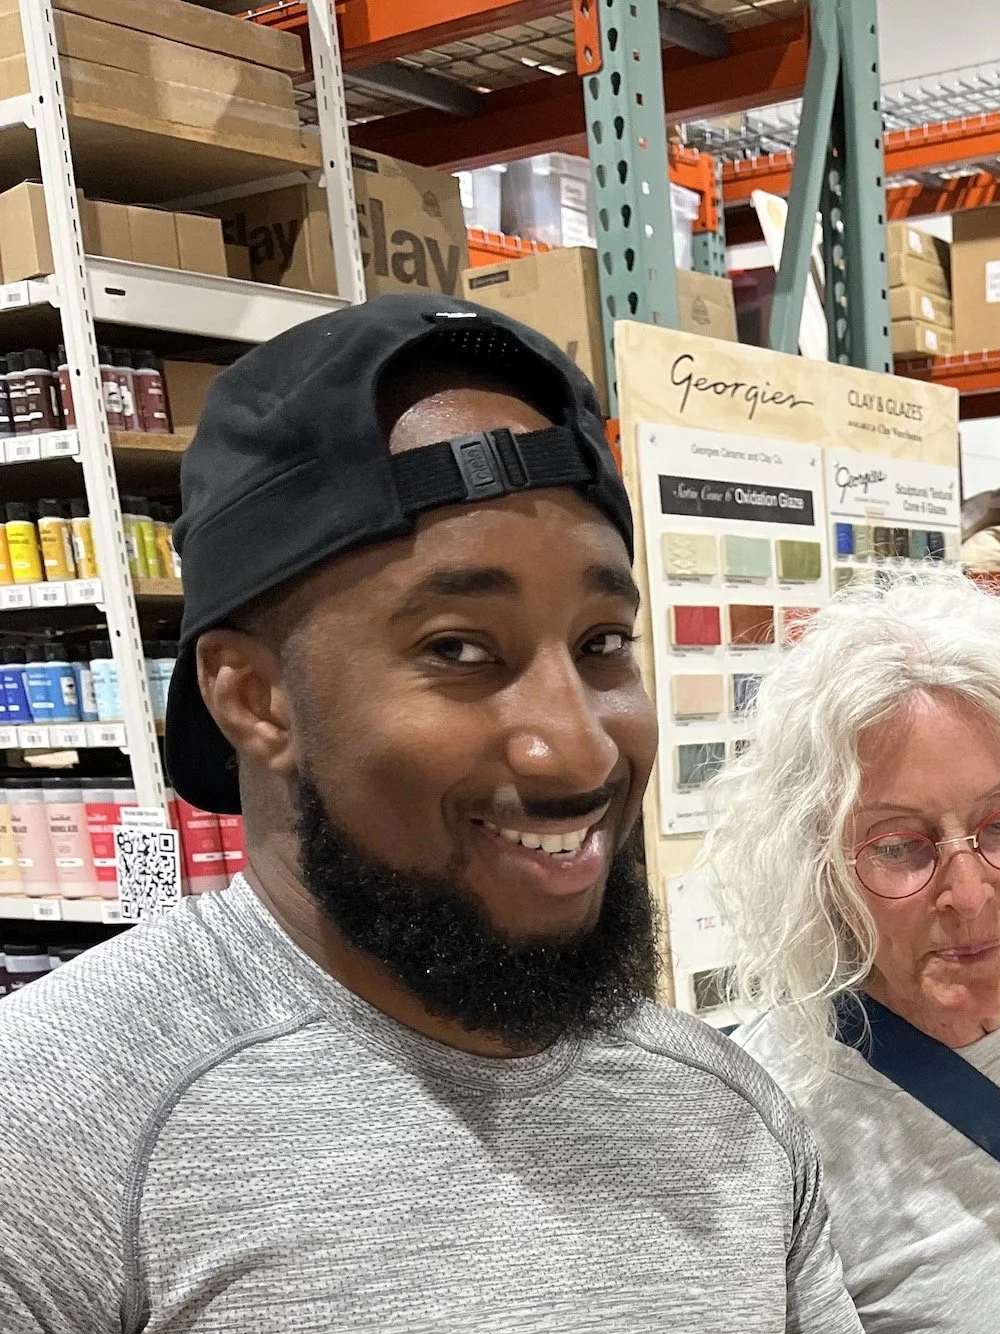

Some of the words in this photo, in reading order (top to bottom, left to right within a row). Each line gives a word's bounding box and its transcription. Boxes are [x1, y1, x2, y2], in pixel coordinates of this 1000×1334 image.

[358, 197, 461, 296] lay
[671, 354, 814, 420] Georgies
[847, 389, 876, 410] CLAY
[885, 399, 923, 421] GLAZES
[734, 488, 778, 506] Oxidation
